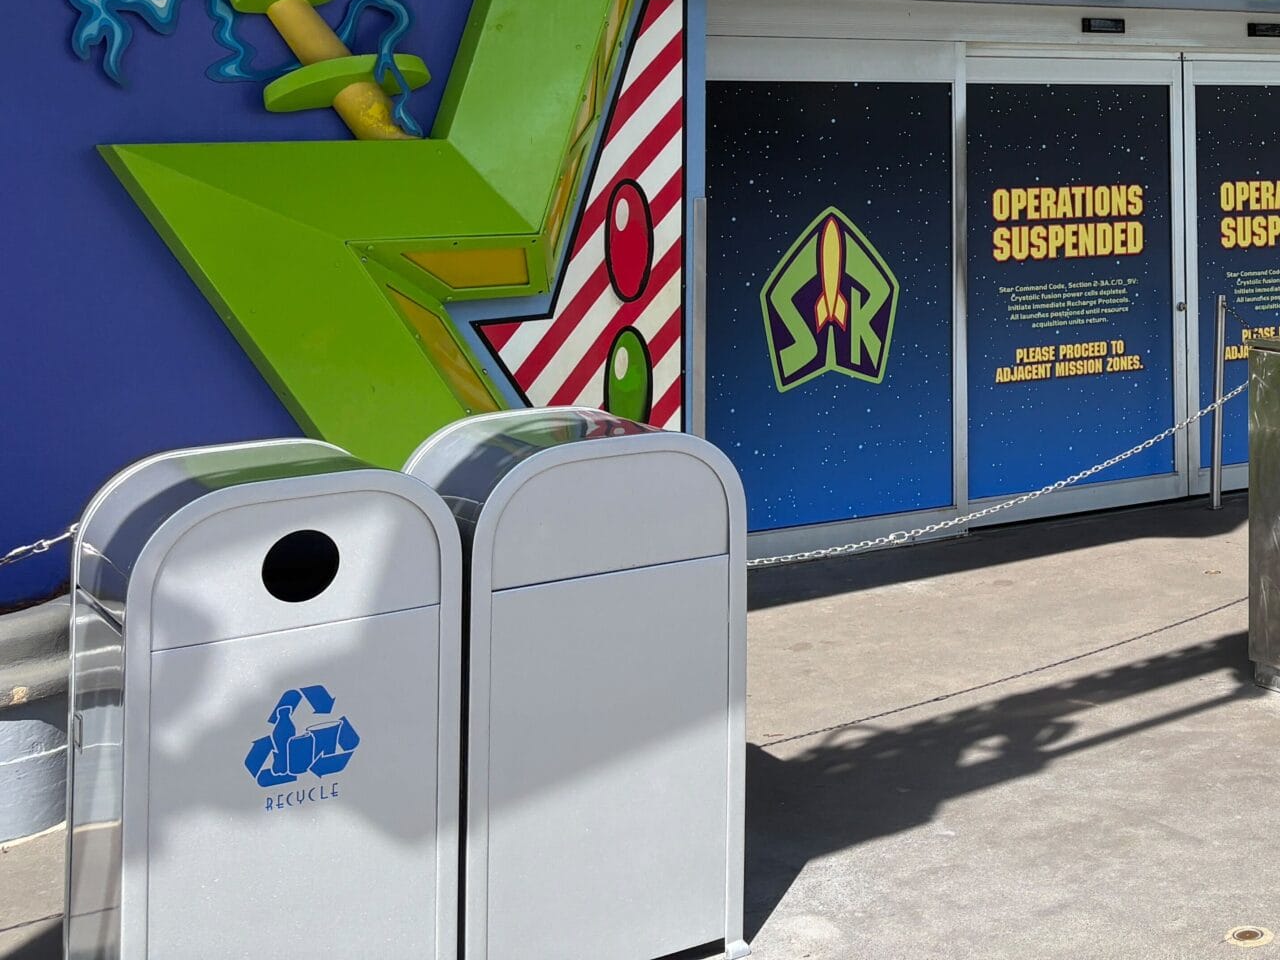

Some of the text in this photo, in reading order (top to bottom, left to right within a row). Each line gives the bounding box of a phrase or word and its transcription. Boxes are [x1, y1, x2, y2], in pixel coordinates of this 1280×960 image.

[992, 184, 1144, 222] OPERATIONS
[992, 221, 1144, 262] SUSPENDED
[999, 286, 1014, 294] Star
[1015, 283, 1048, 293] Command
[1068, 280, 1092, 290] Section
[1041, 290, 1062, 300] fusion
[1062, 290, 1083, 300] power
[1084, 288, 1098, 297] cells
[1010, 312, 1020, 321] All
[1050, 308, 1085, 319] postponed
[1085, 307, 1100, 316] until
[1100, 305, 1129, 314] resource
[1066, 299, 1097, 309] Recharge
[1031, 316, 1109, 329] acquisition units return.
[1015, 339, 1125, 364] PLEASE PROCEED TO
[994, 354, 1144, 383] ADJACENT MISSION ZONES.
[265, 782, 339, 812] RECYCLE
